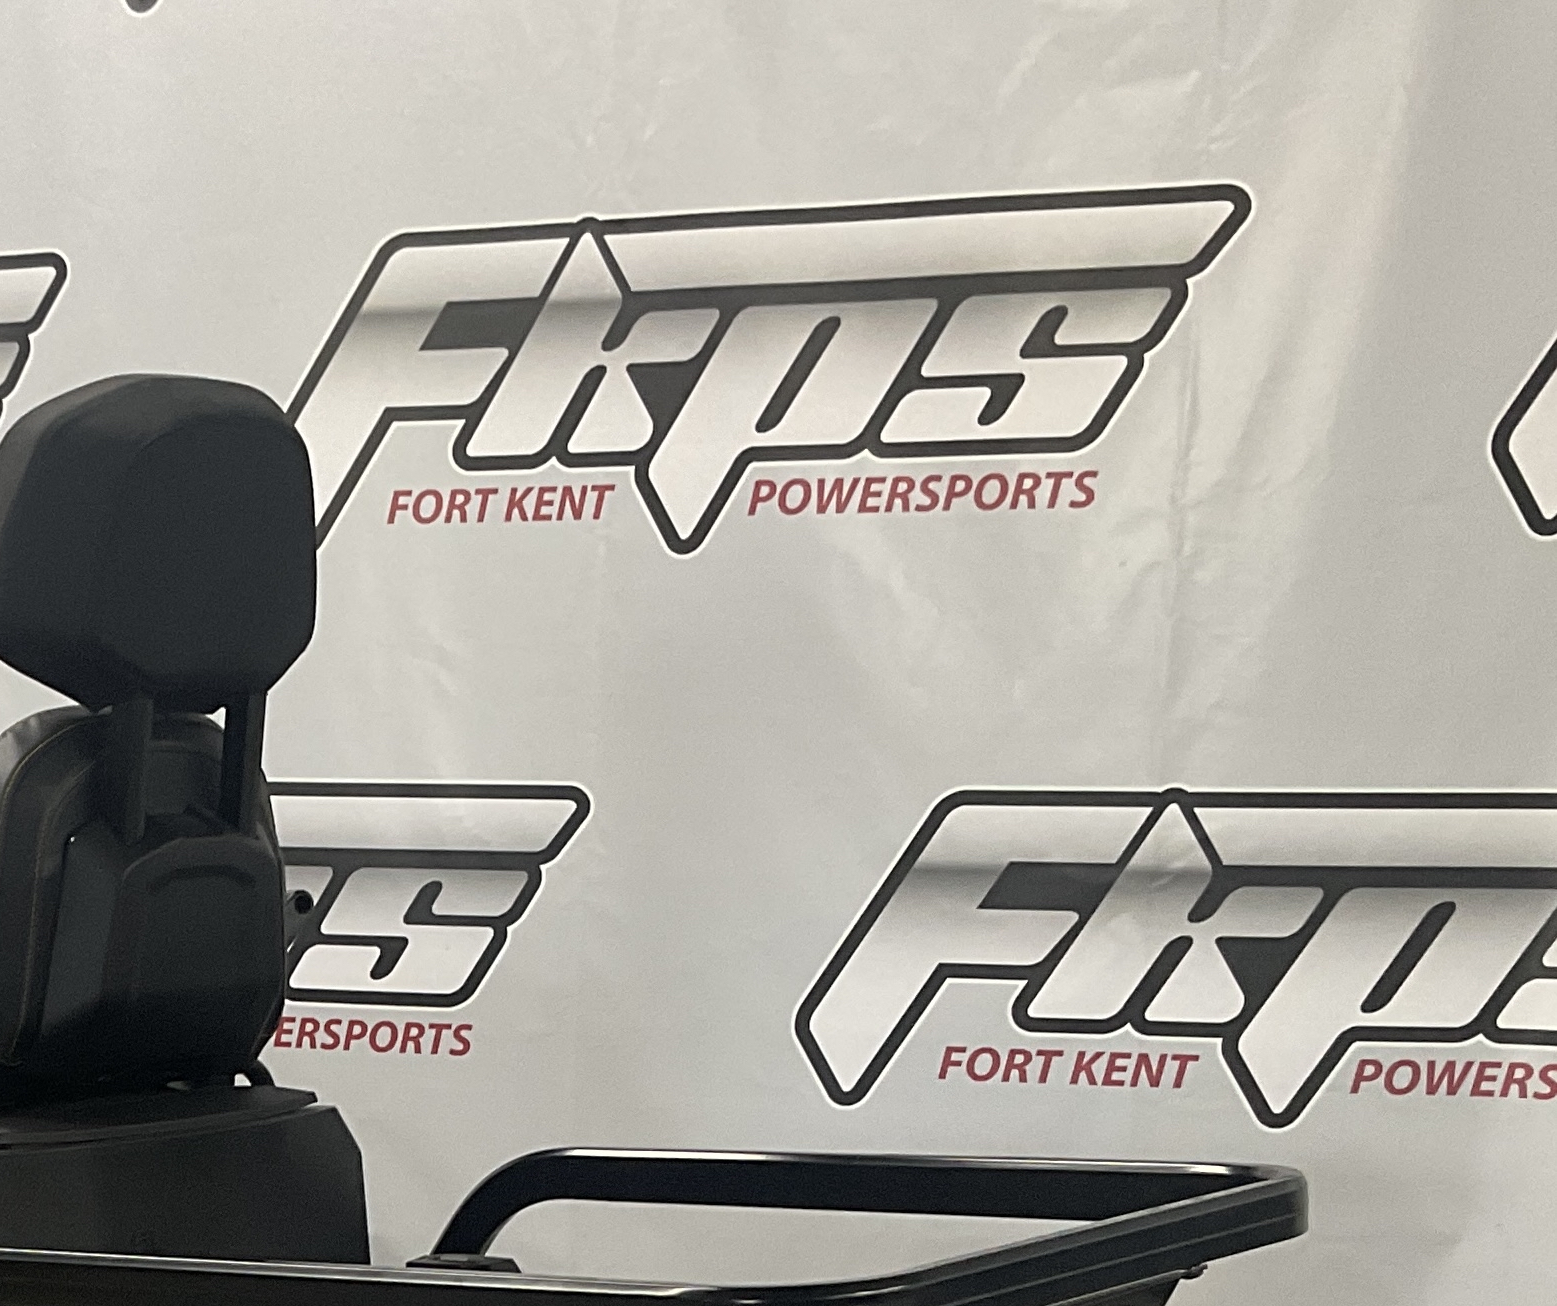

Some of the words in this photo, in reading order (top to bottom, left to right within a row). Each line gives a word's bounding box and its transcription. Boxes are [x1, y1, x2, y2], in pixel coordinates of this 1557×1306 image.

[386, 487, 500, 525] FORT
[502, 483, 616, 523] KENT
[747, 469, 1099, 517] POWERSPORTS
[273, 1016, 474, 1057] ERSPORTS
[938, 1045, 1065, 1085] FORT
[1069, 1050, 1201, 1089] KENT
[1349, 1058, 1557, 1101] POWERS
